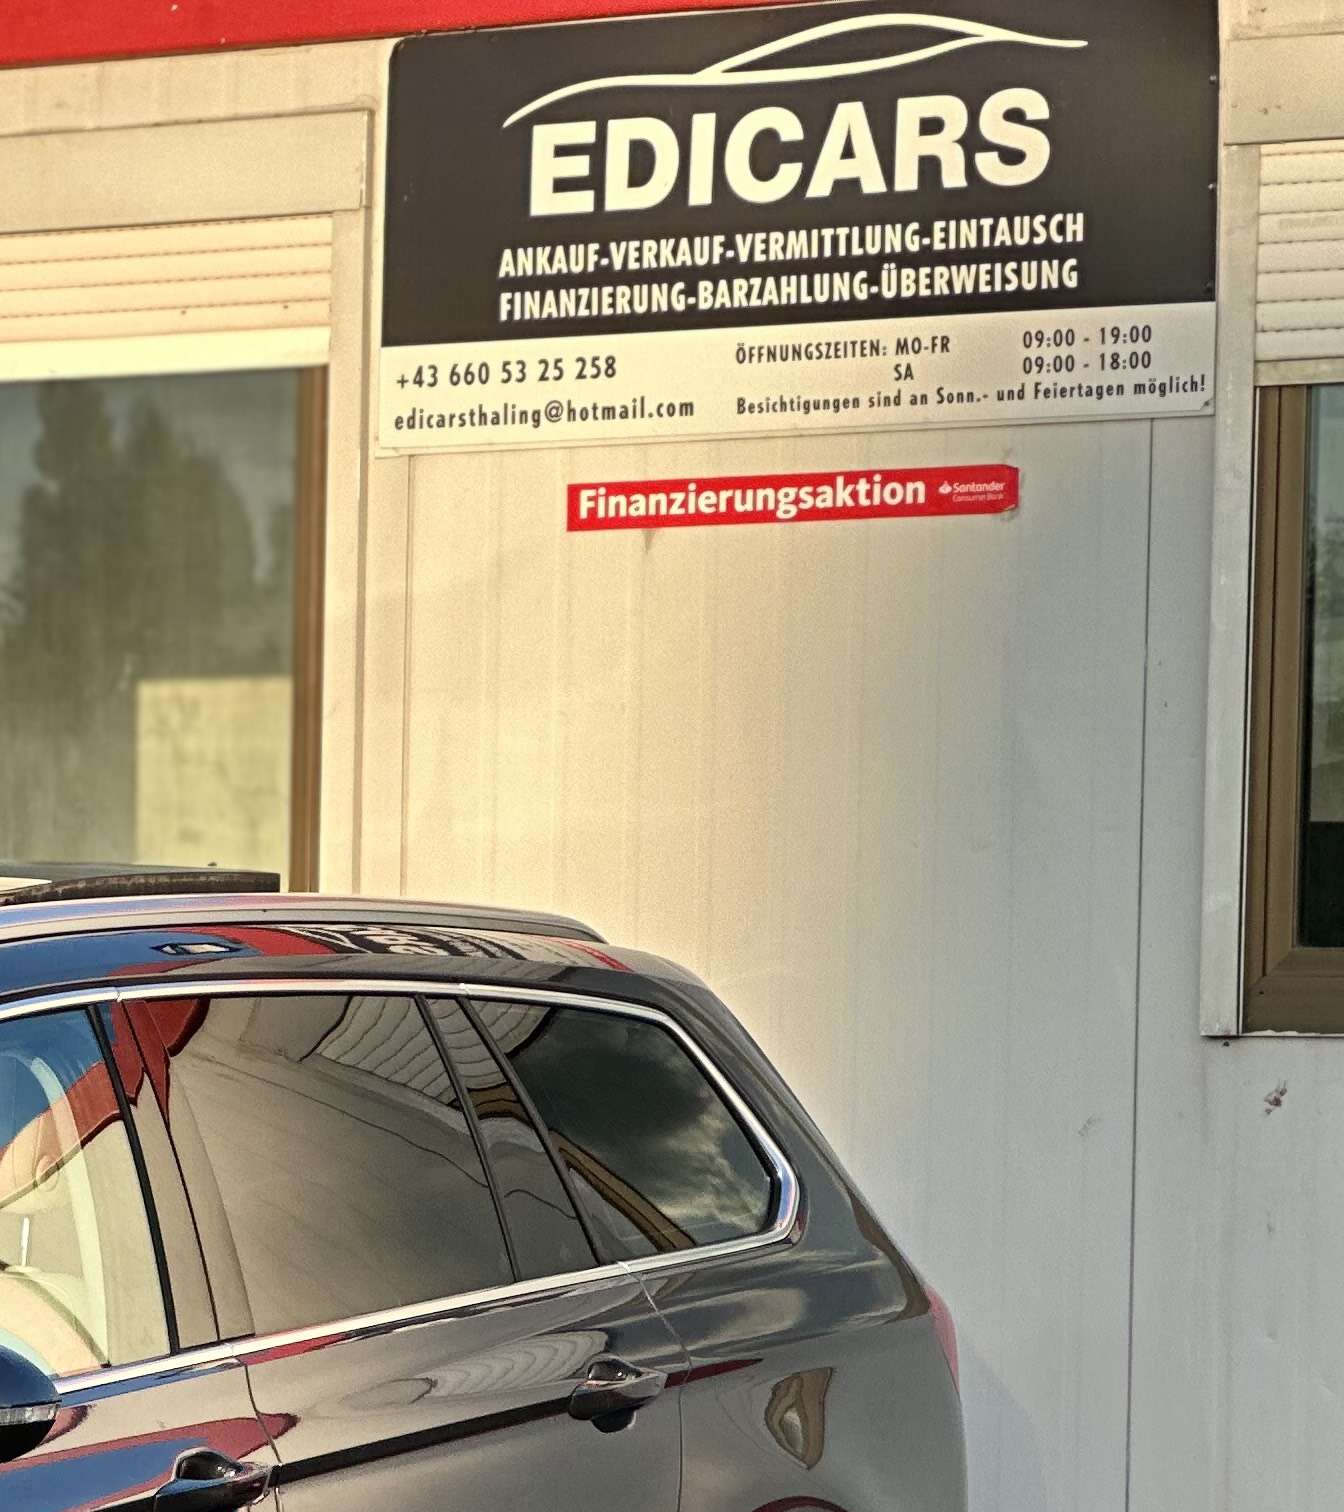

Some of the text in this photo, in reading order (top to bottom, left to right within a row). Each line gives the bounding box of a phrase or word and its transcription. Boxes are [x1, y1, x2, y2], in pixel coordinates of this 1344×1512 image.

[529, 87, 1051, 217] EDICARS
[498, 212, 1085, 278] ANKAUF-VERKAUF-VERMITTLUNG-EINTAUSCH
[499, 258, 1079, 321] FINANZIERUNG-BARZAHLUNG-ÜBERWEISUNG
[735, 339, 888, 365] ÖFFNUNGSZEITEN:
[895, 335, 951, 356] MO-FR
[1023, 328, 1076, 348] 09:00
[1099, 325, 1152, 345] 19:00
[396, 355, 617, 389] +43 660 53 25 258
[893, 363, 914, 381] SA
[1023, 354, 1075, 374] 09:00
[1099, 351, 1152, 371] 18:00
[394, 396, 695, 431] edicarsthaling@hotmail.com
[736, 374, 1207, 415] Besichtigungen sind an Sonn.- und Feiertagen möglich!
[578, 473, 926, 520] Finanzierungsaktion
[952, 480, 1006, 493] Santander
